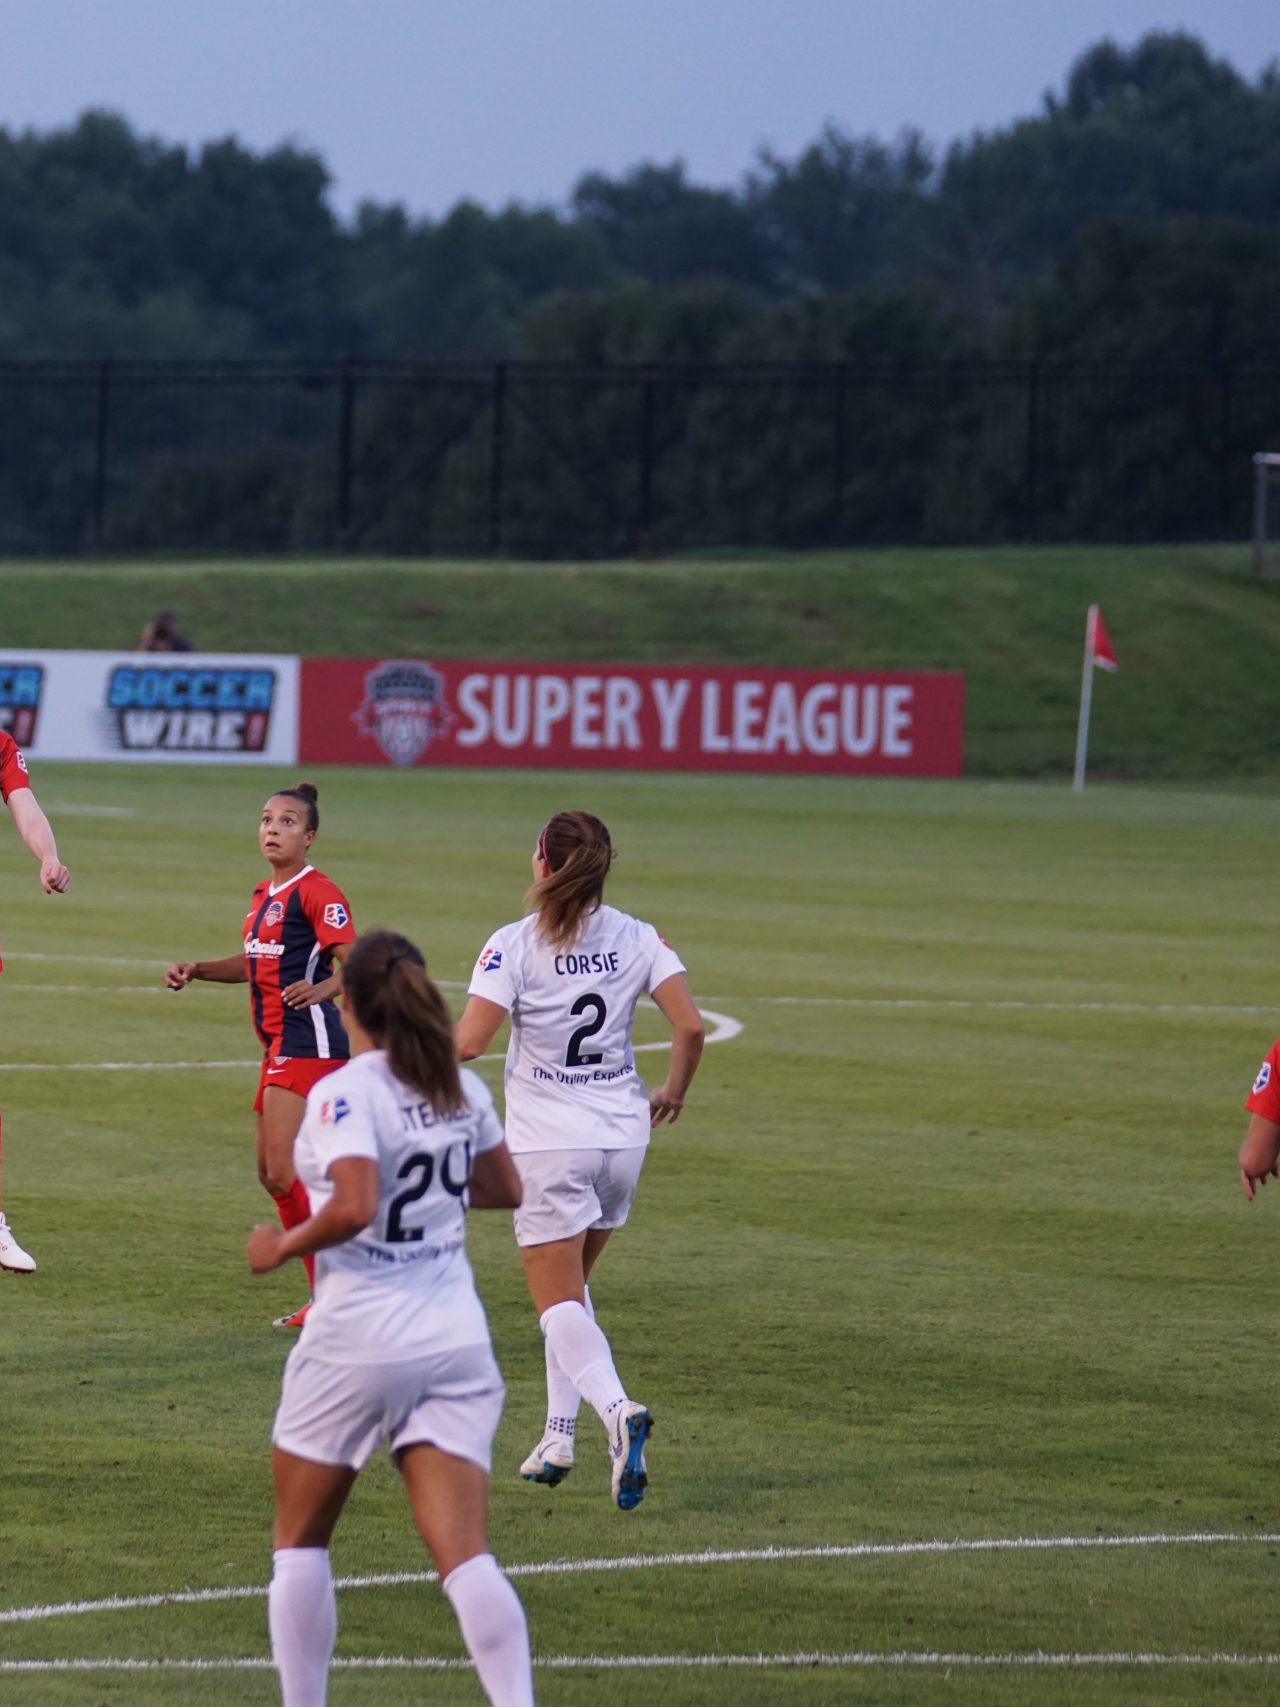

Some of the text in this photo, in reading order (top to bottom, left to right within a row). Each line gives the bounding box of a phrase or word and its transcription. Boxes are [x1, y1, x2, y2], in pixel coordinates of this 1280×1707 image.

[108, 667, 275, 709] SOCCER
[456, 674, 642, 749] SUPER
[652, 678, 690, 751] Y
[701, 681, 913, 757] LEAGUE
[554, 952, 619, 975] CORSIE
[565, 993, 607, 1067] 2
[532, 1067, 554, 1080] The
[556, 1071, 591, 1085] Utility
